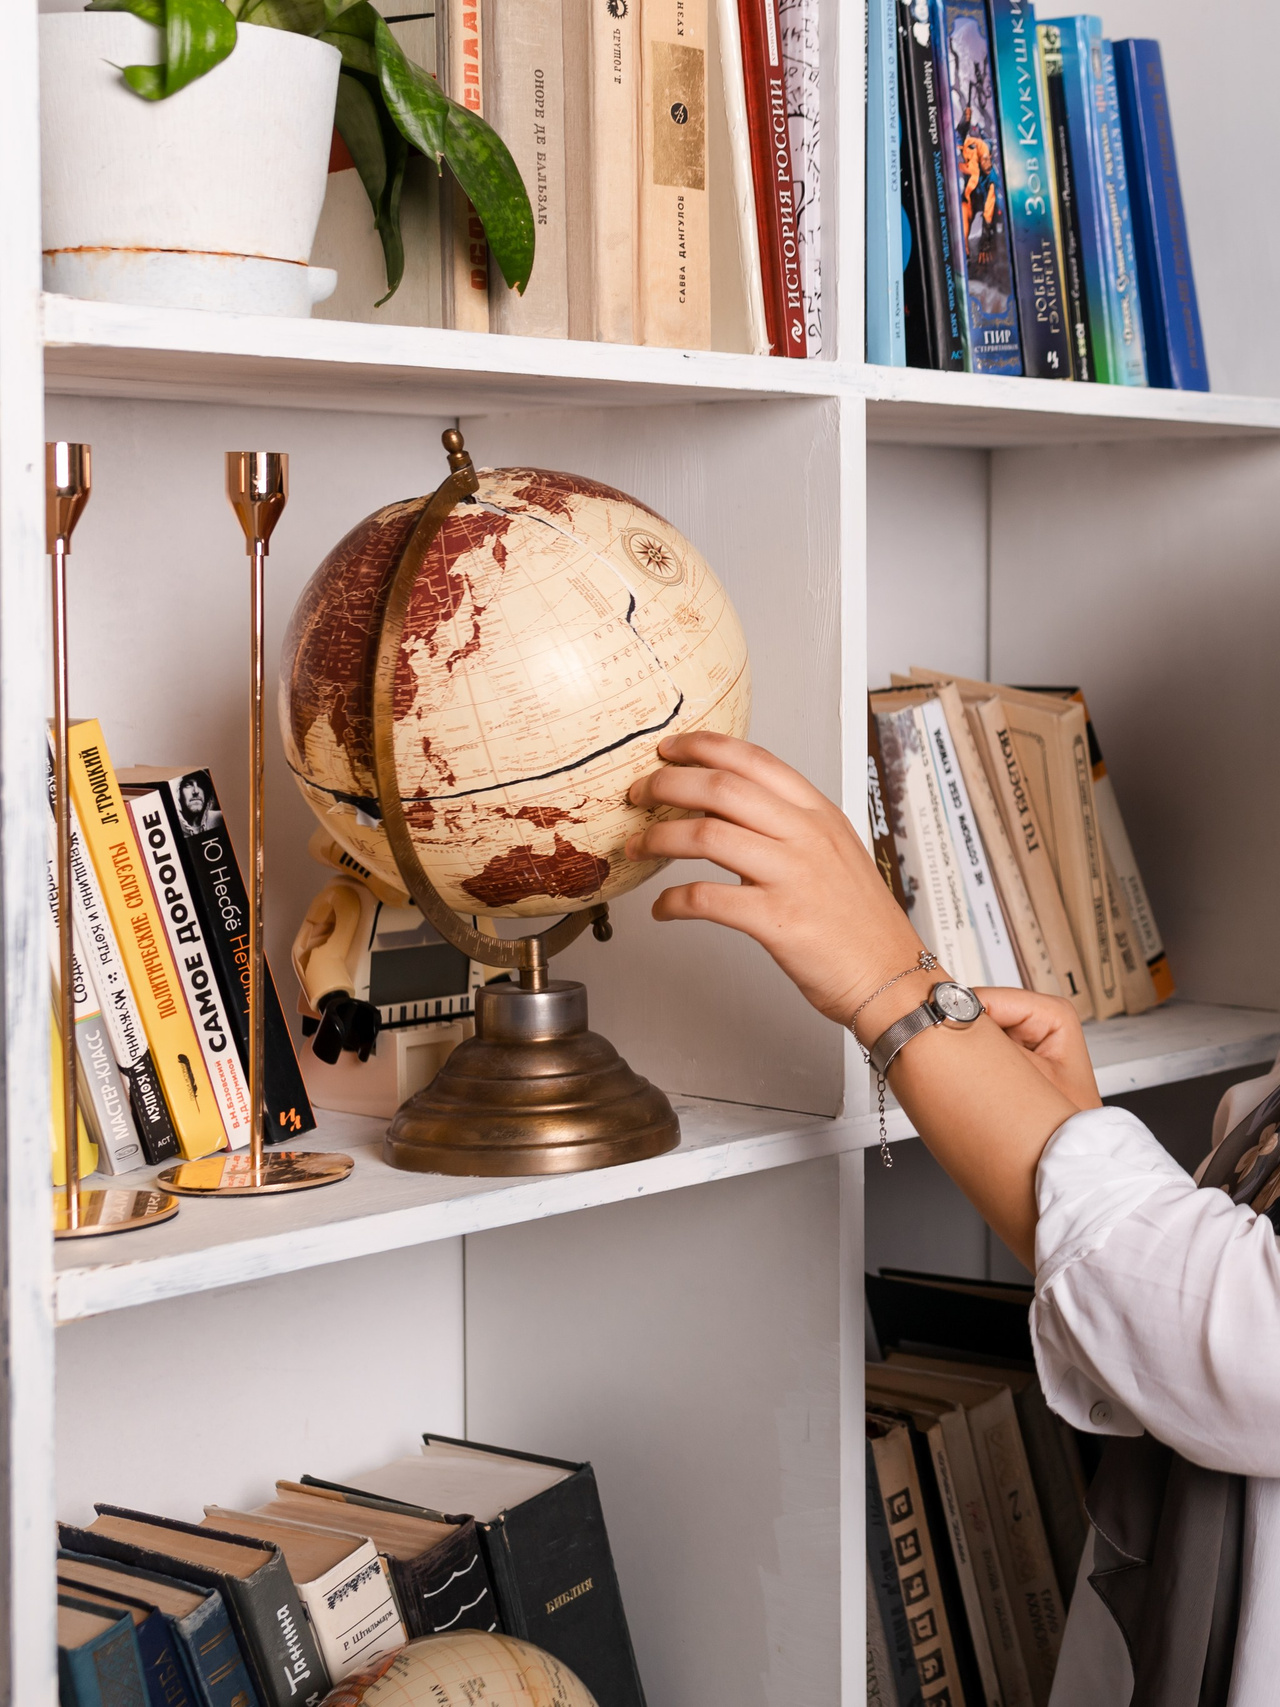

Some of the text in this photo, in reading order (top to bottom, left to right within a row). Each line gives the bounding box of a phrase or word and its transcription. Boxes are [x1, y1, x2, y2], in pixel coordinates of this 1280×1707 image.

[463, 0, 481, 110] СПЛА
[613, 28, 622, 73] РОШАЛЬ
[888, 56, 895, 65] О
[888, 70, 897, 128] РАССКАЗЫ
[922, 59, 939, 145] Марта Кетро
[534, 69, 547, 225] ОНОРЕ ДЕ БАЛЬЗАК
[889, 134, 897, 144] И
[769, 79, 800, 309] ИСТОРИЯ РОССИИ
[889, 154, 898, 192] СКАЗКИ
[677, 195, 687, 303] САВВА ДАНГУЛОВ
[1031, 251, 1048, 322] РОБЕРТ
[984, 330, 1011, 345] ПИР
[932, 727, 986, 887] НЕ СОТВОРИ СЕБЕ КУМИРА
[201, 836, 224, 862] Ю
[108, 841, 178, 1020] ПОЛИТИЧЕСКИЕ СИЛУЭТЫ
[141, 808, 228, 1053] САМОЕ ДОРОГОЕ
[209, 865, 242, 932] Несбё
[94, 1029, 130, 1141] МАСТЕР-КЛАСС
[156, 1135, 172, 1149] АСТ
[545, 1577, 594, 1615] БИБЛИЯ
[343, 1609, 393, 1651] Р. Штильмарк
